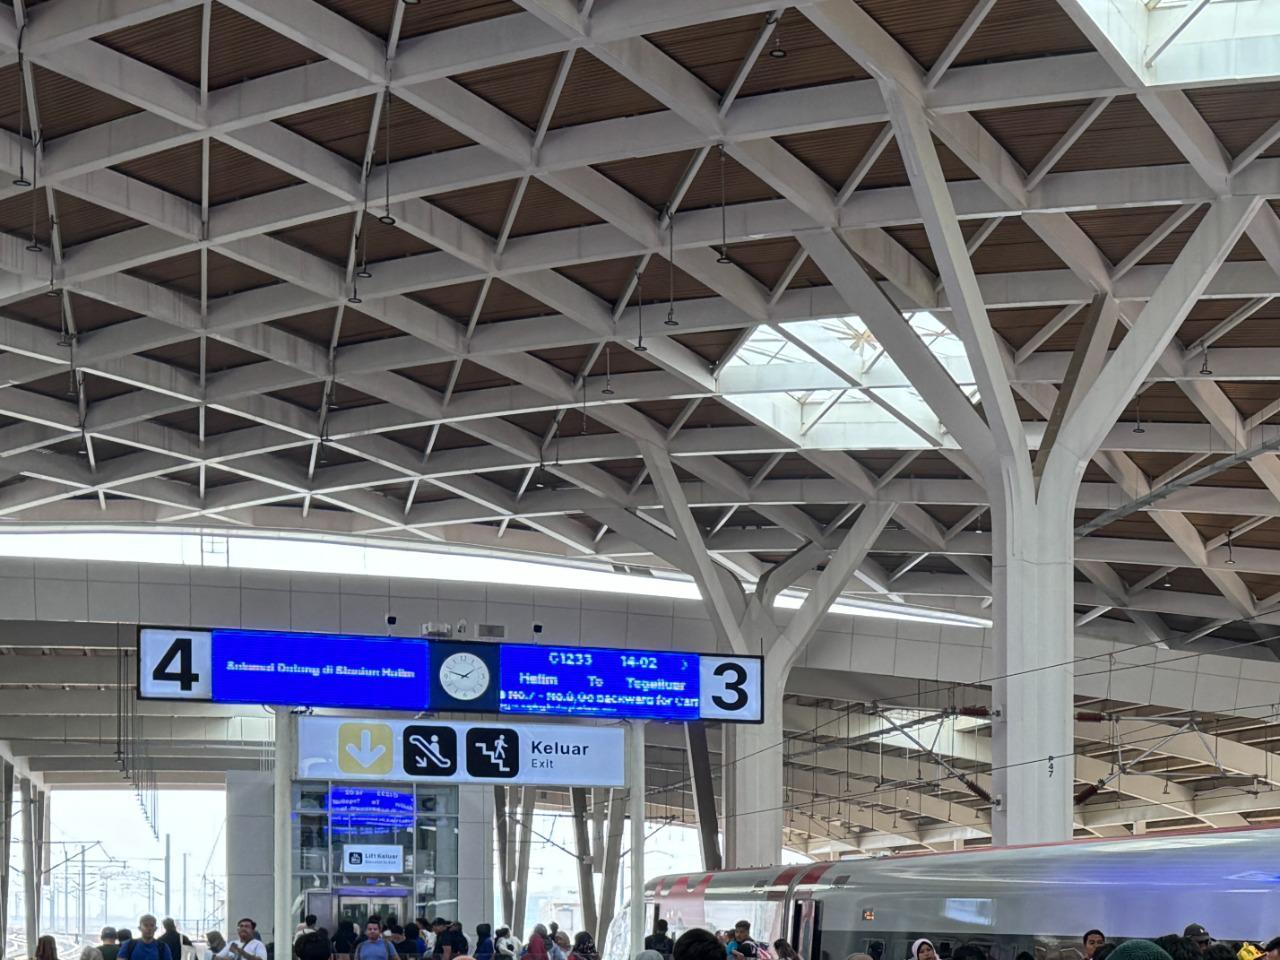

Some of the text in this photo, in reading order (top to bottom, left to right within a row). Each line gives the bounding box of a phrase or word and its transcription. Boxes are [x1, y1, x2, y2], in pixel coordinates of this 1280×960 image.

[152, 638, 199, 691] 4
[549, 652, 593, 666] G1233
[587, 676, 604, 687] To
[711, 662, 749, 711] 3
[531, 740, 589, 756] Keluar
[531, 759, 554, 768] Exit
